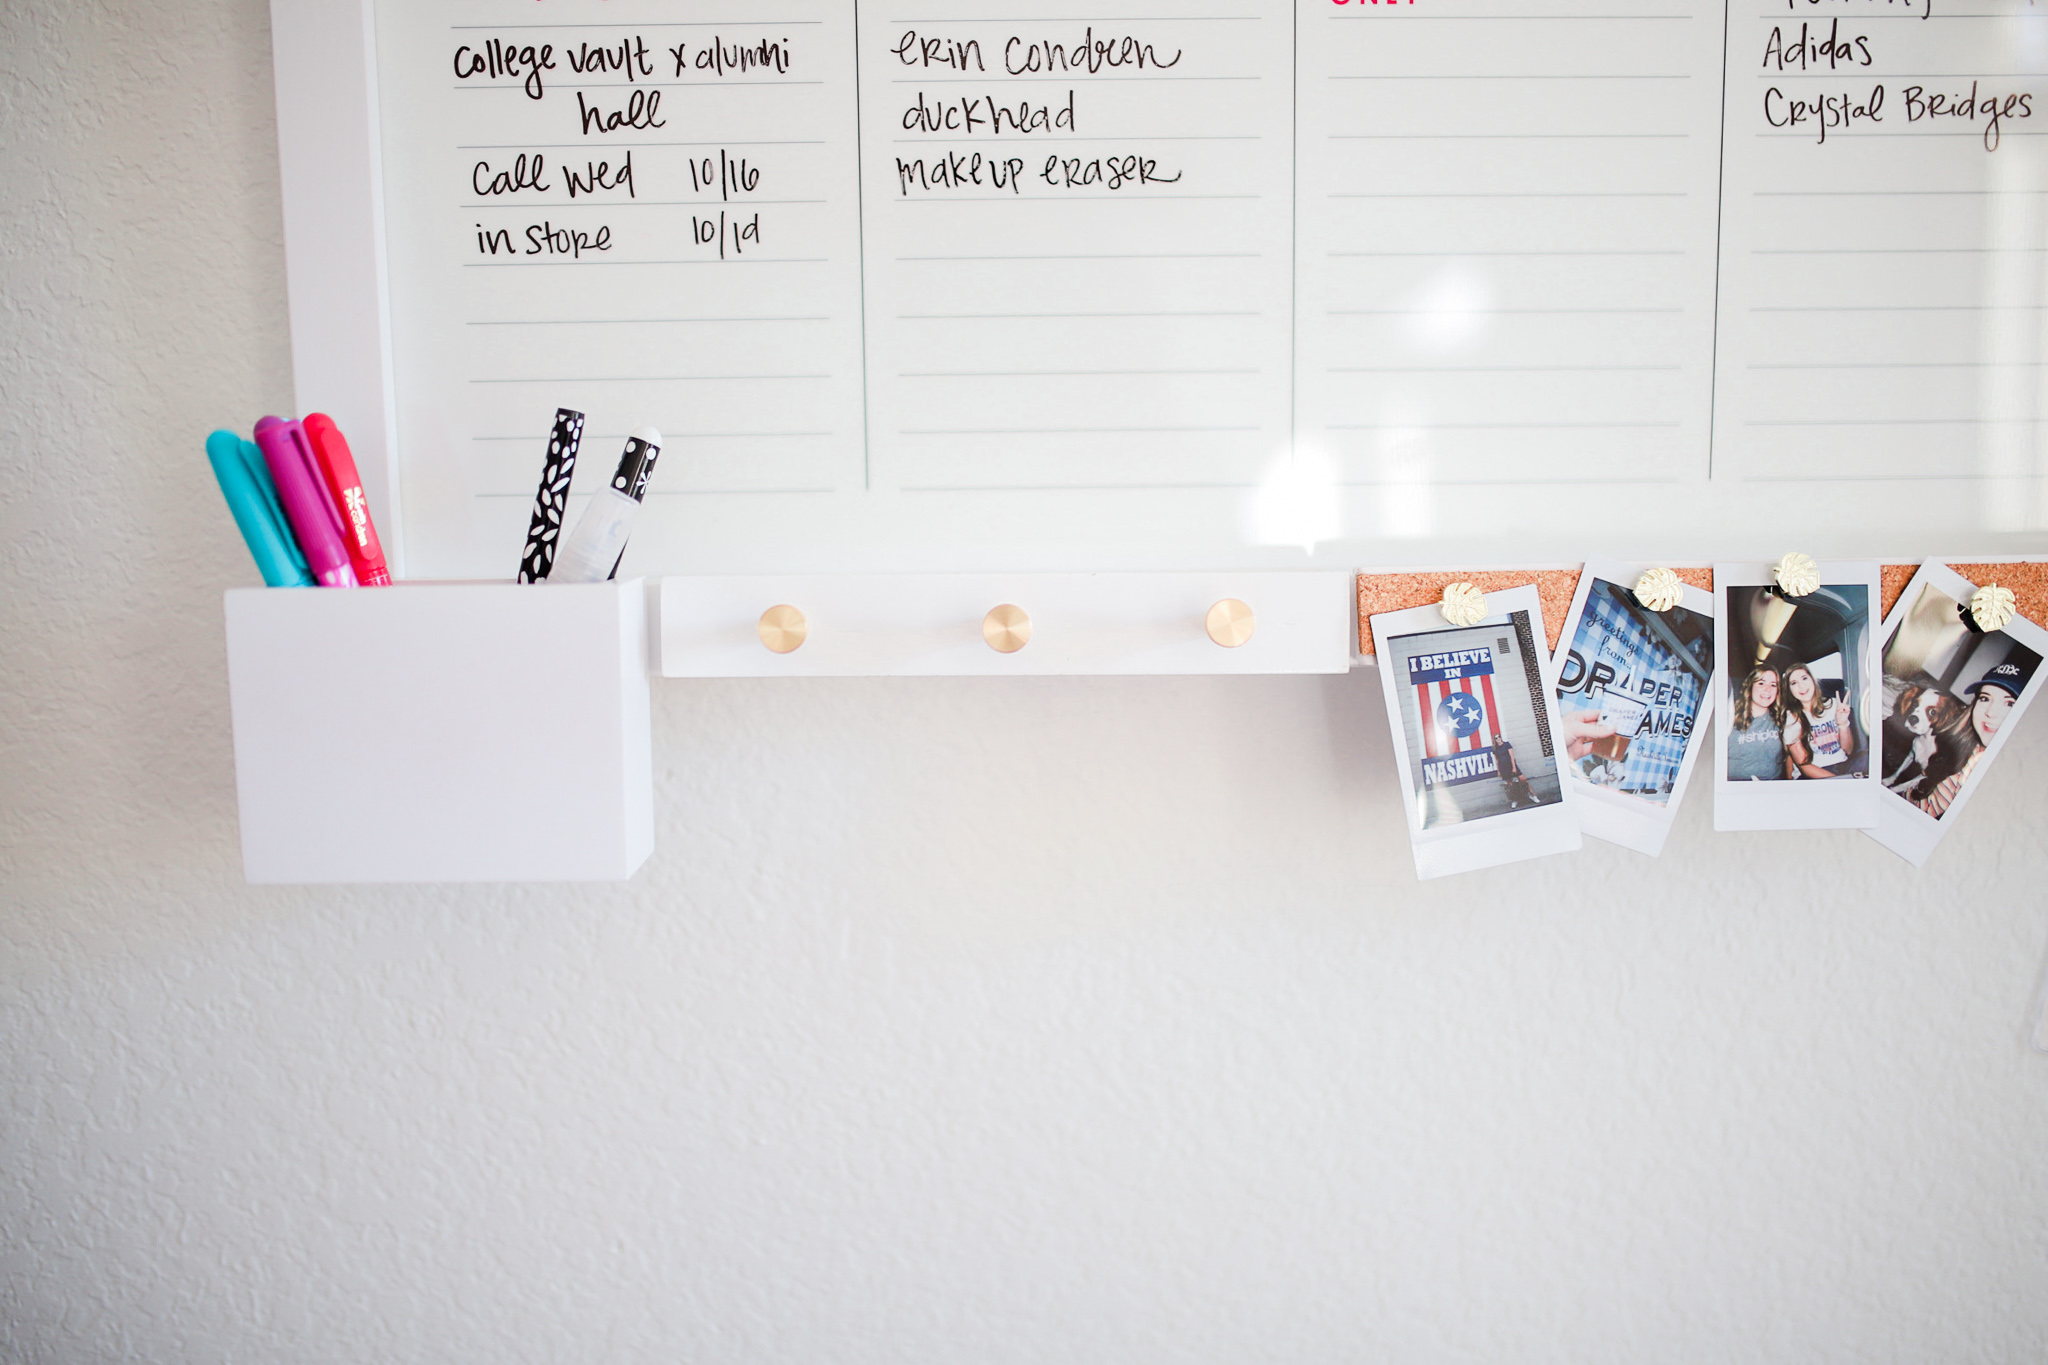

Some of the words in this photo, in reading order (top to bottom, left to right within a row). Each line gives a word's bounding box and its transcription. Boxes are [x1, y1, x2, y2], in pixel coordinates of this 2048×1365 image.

[567, 36, 653, 82] vault
[1763, 17, 1872, 70] Adidas
[577, 90, 666, 135] hall
[903, 90, 1075, 134] duckhead
[1764, 84, 1885, 145] Crystal
[1903, 80, 2033, 152] Bridges
[689, 149, 760, 201] 10/16
[1040, 155, 1182, 190] eraser
[475, 223, 516, 255] in
[1409, 657, 1419, 673] I
[1420, 648, 1491, 671] BELIEVE
[1444, 667, 1462, 679] IN
[1634, 709, 1693, 740] AMES
